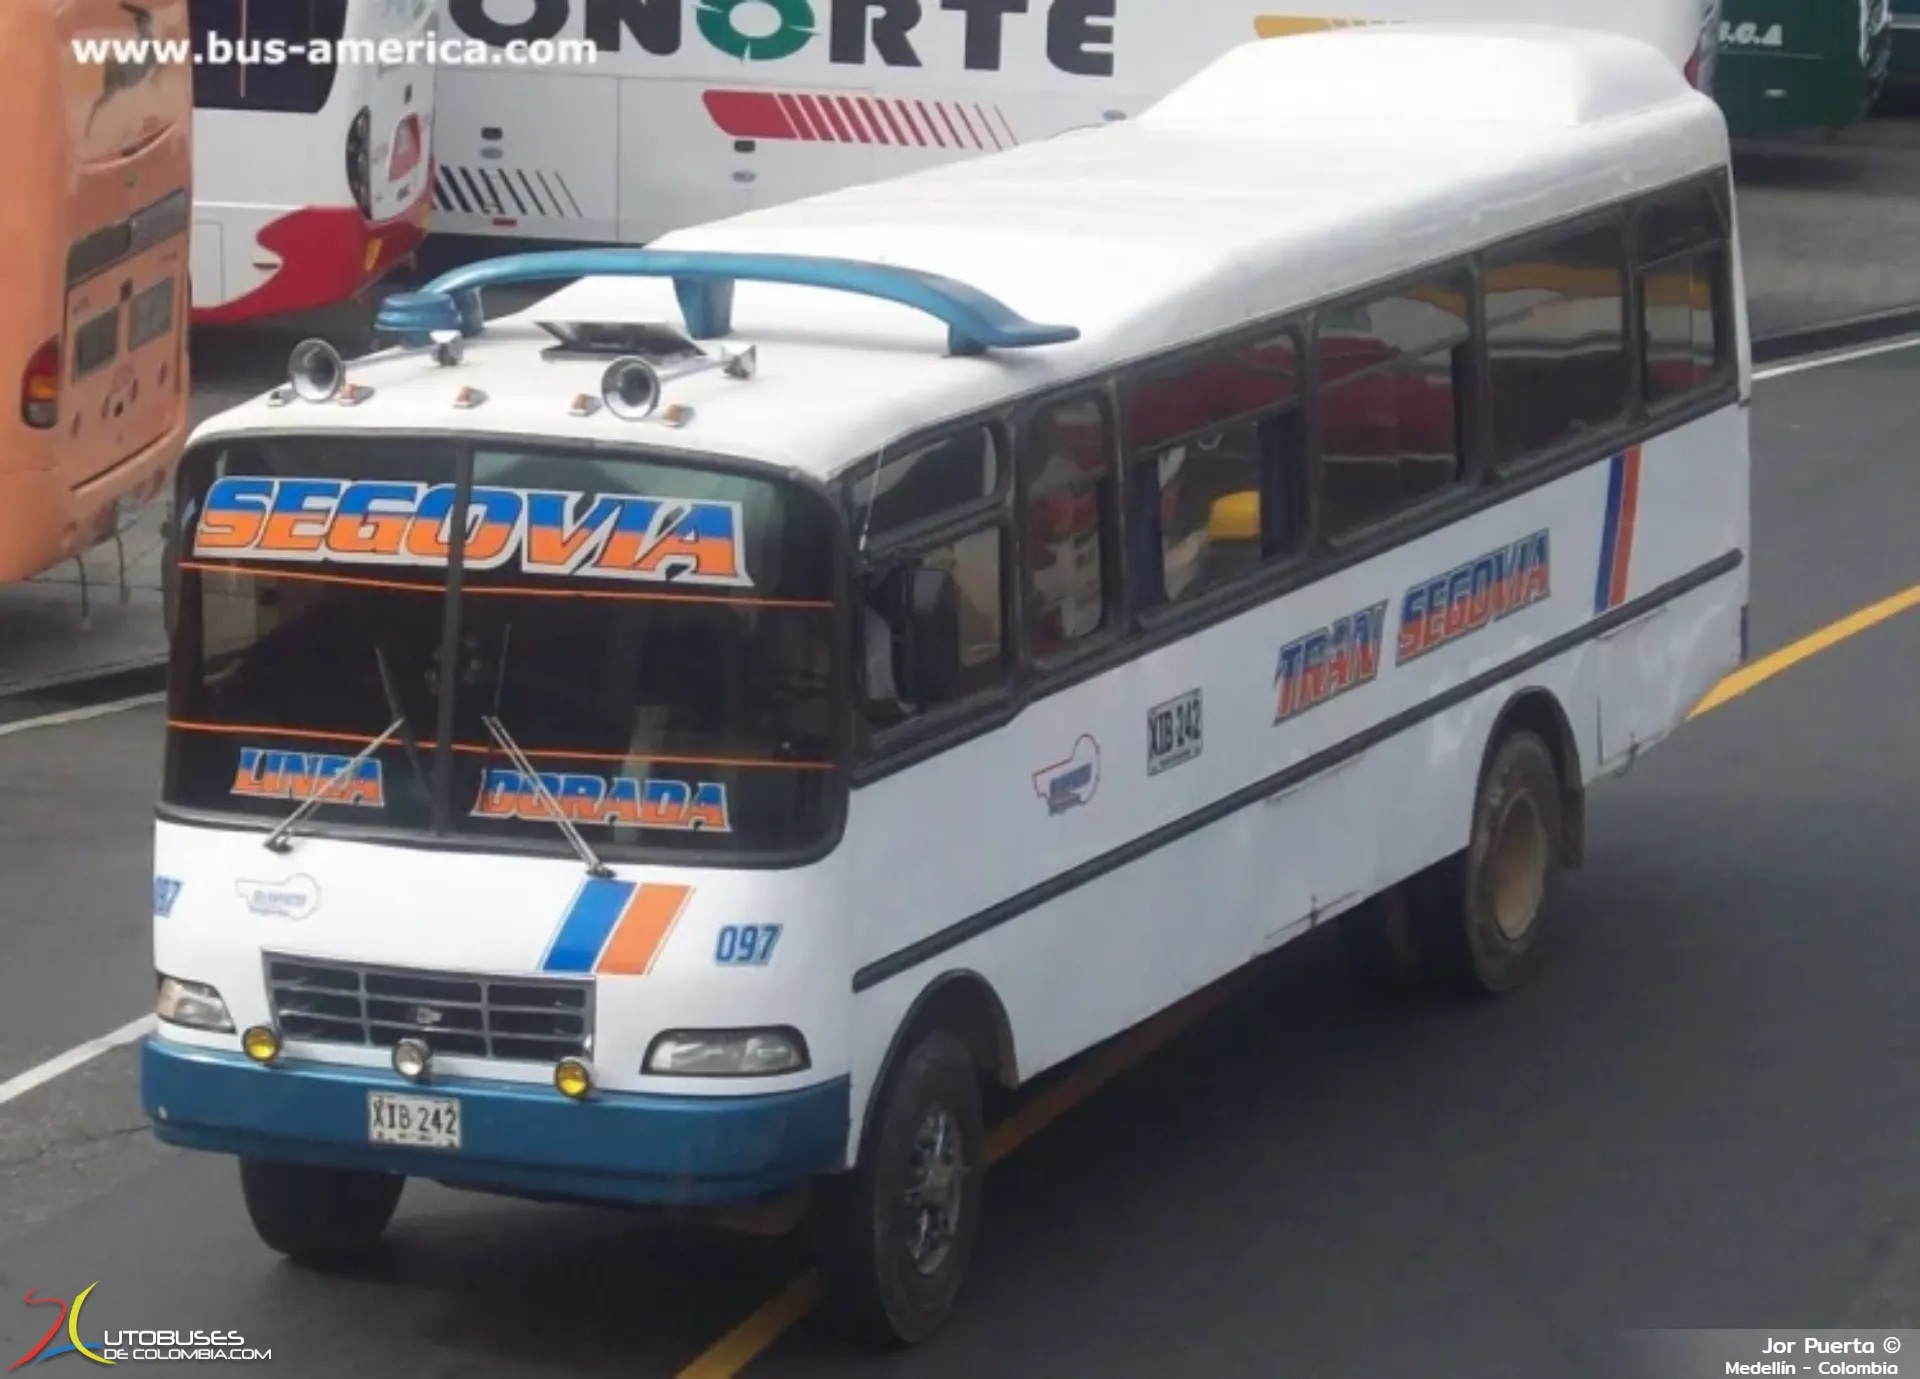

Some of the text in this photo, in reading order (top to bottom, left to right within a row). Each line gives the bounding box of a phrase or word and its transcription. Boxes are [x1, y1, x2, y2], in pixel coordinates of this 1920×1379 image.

[196, 477, 753, 586] SEGOVIA
[1273, 528, 1551, 726] TRAN SEGOVIA
[231, 747, 732, 832] LINEA DORADA
[715, 924, 782, 966] 097
